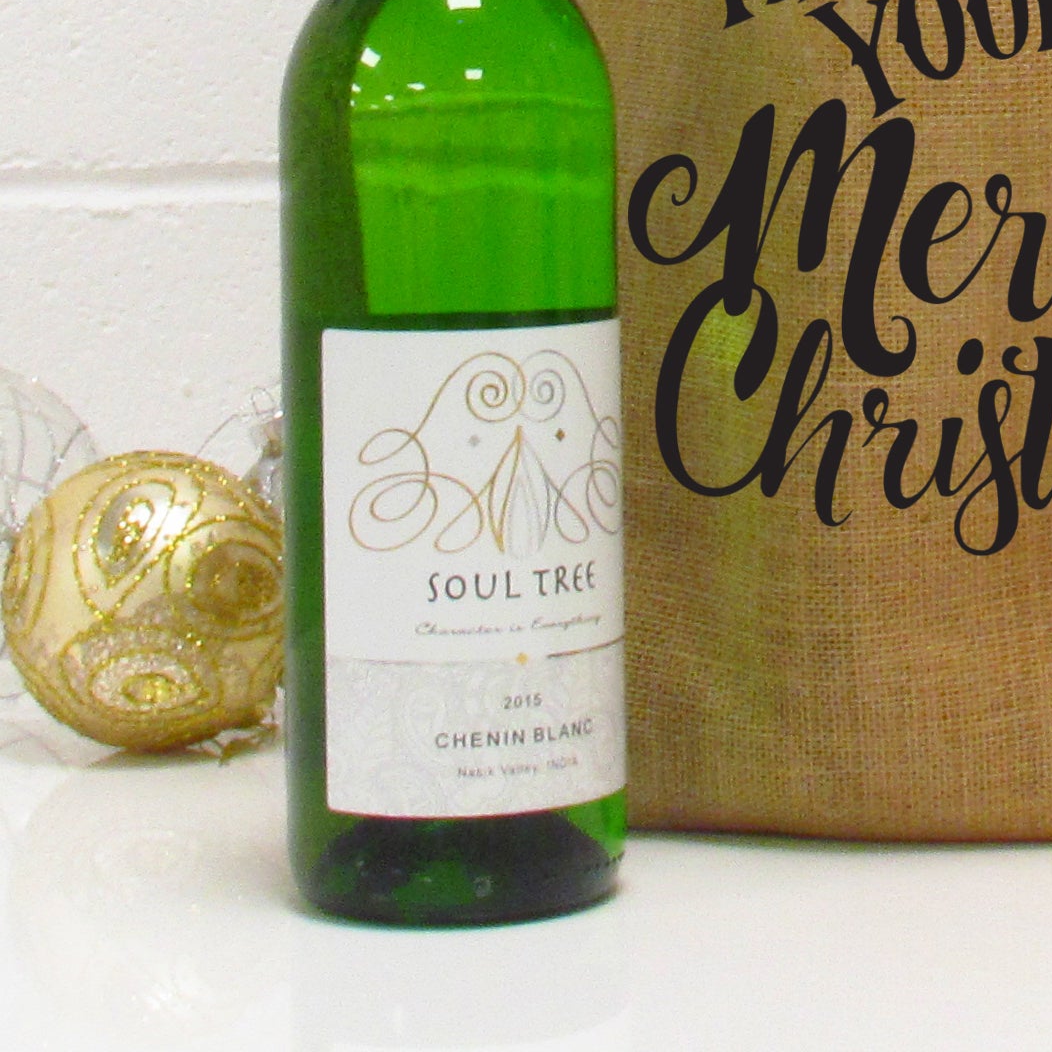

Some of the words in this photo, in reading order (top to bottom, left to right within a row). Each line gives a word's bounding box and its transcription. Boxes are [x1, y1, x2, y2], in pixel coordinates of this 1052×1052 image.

[428, 570, 521, 602] SOUL
[533, 560, 596, 597] TREE
[504, 692, 543, 710] 2015
[435, 729, 526, 749] CHENIN
[533, 718, 593, 743] BLANC
